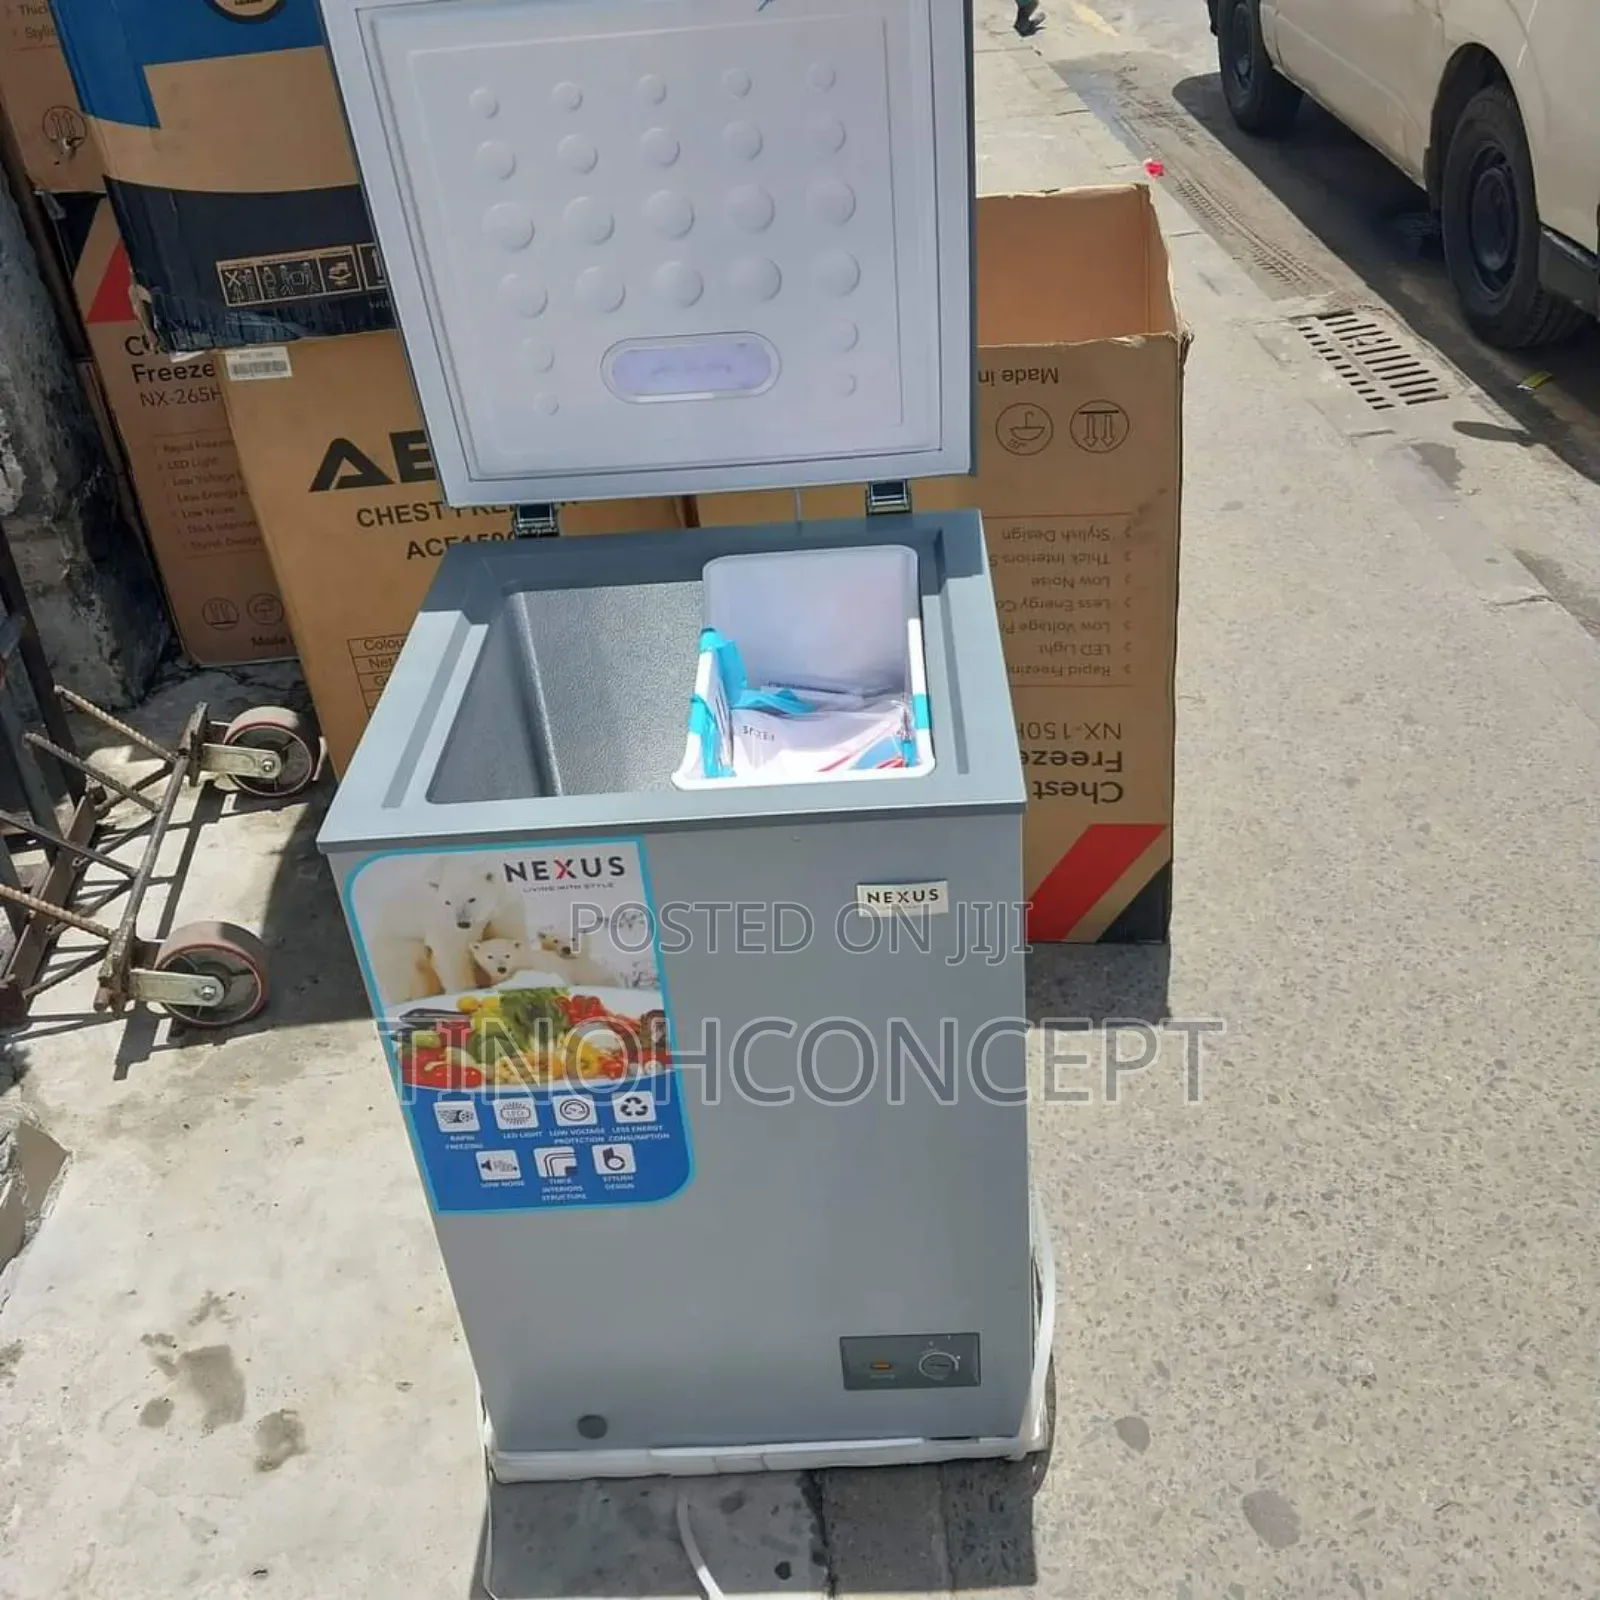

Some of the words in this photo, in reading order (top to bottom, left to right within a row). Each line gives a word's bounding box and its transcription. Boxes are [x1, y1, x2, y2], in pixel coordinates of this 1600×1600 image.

[131, 363, 215, 383] Freeze
[978, 369, 995, 384] in
[1002, 367, 1059, 384] Made
[356, 501, 443, 528] CHEST
[1002, 527, 1056, 543] Design
[1062, 524, 1110, 542] Stylish
[1031, 576, 1075, 589] Noise
[1080, 576, 1110, 588] Low
[1021, 596, 1074, 612] Energy
[1078, 598, 1110, 610] Less
[1019, 619, 1076, 634] Voltage
[1081, 621, 1110, 633] Low
[1038, 642, 1076, 656] Light
[1080, 643, 1111, 656] LED
[1007, 664, 1062, 677] Freezin
[1068, 663, 1111, 677] Rapid
[1019, 750, 1122, 773] Freeze
[1033, 781, 1124, 804] Chest
[503, 856, 625, 883] NEXUS
[867, 888, 939, 904] NEXUS
